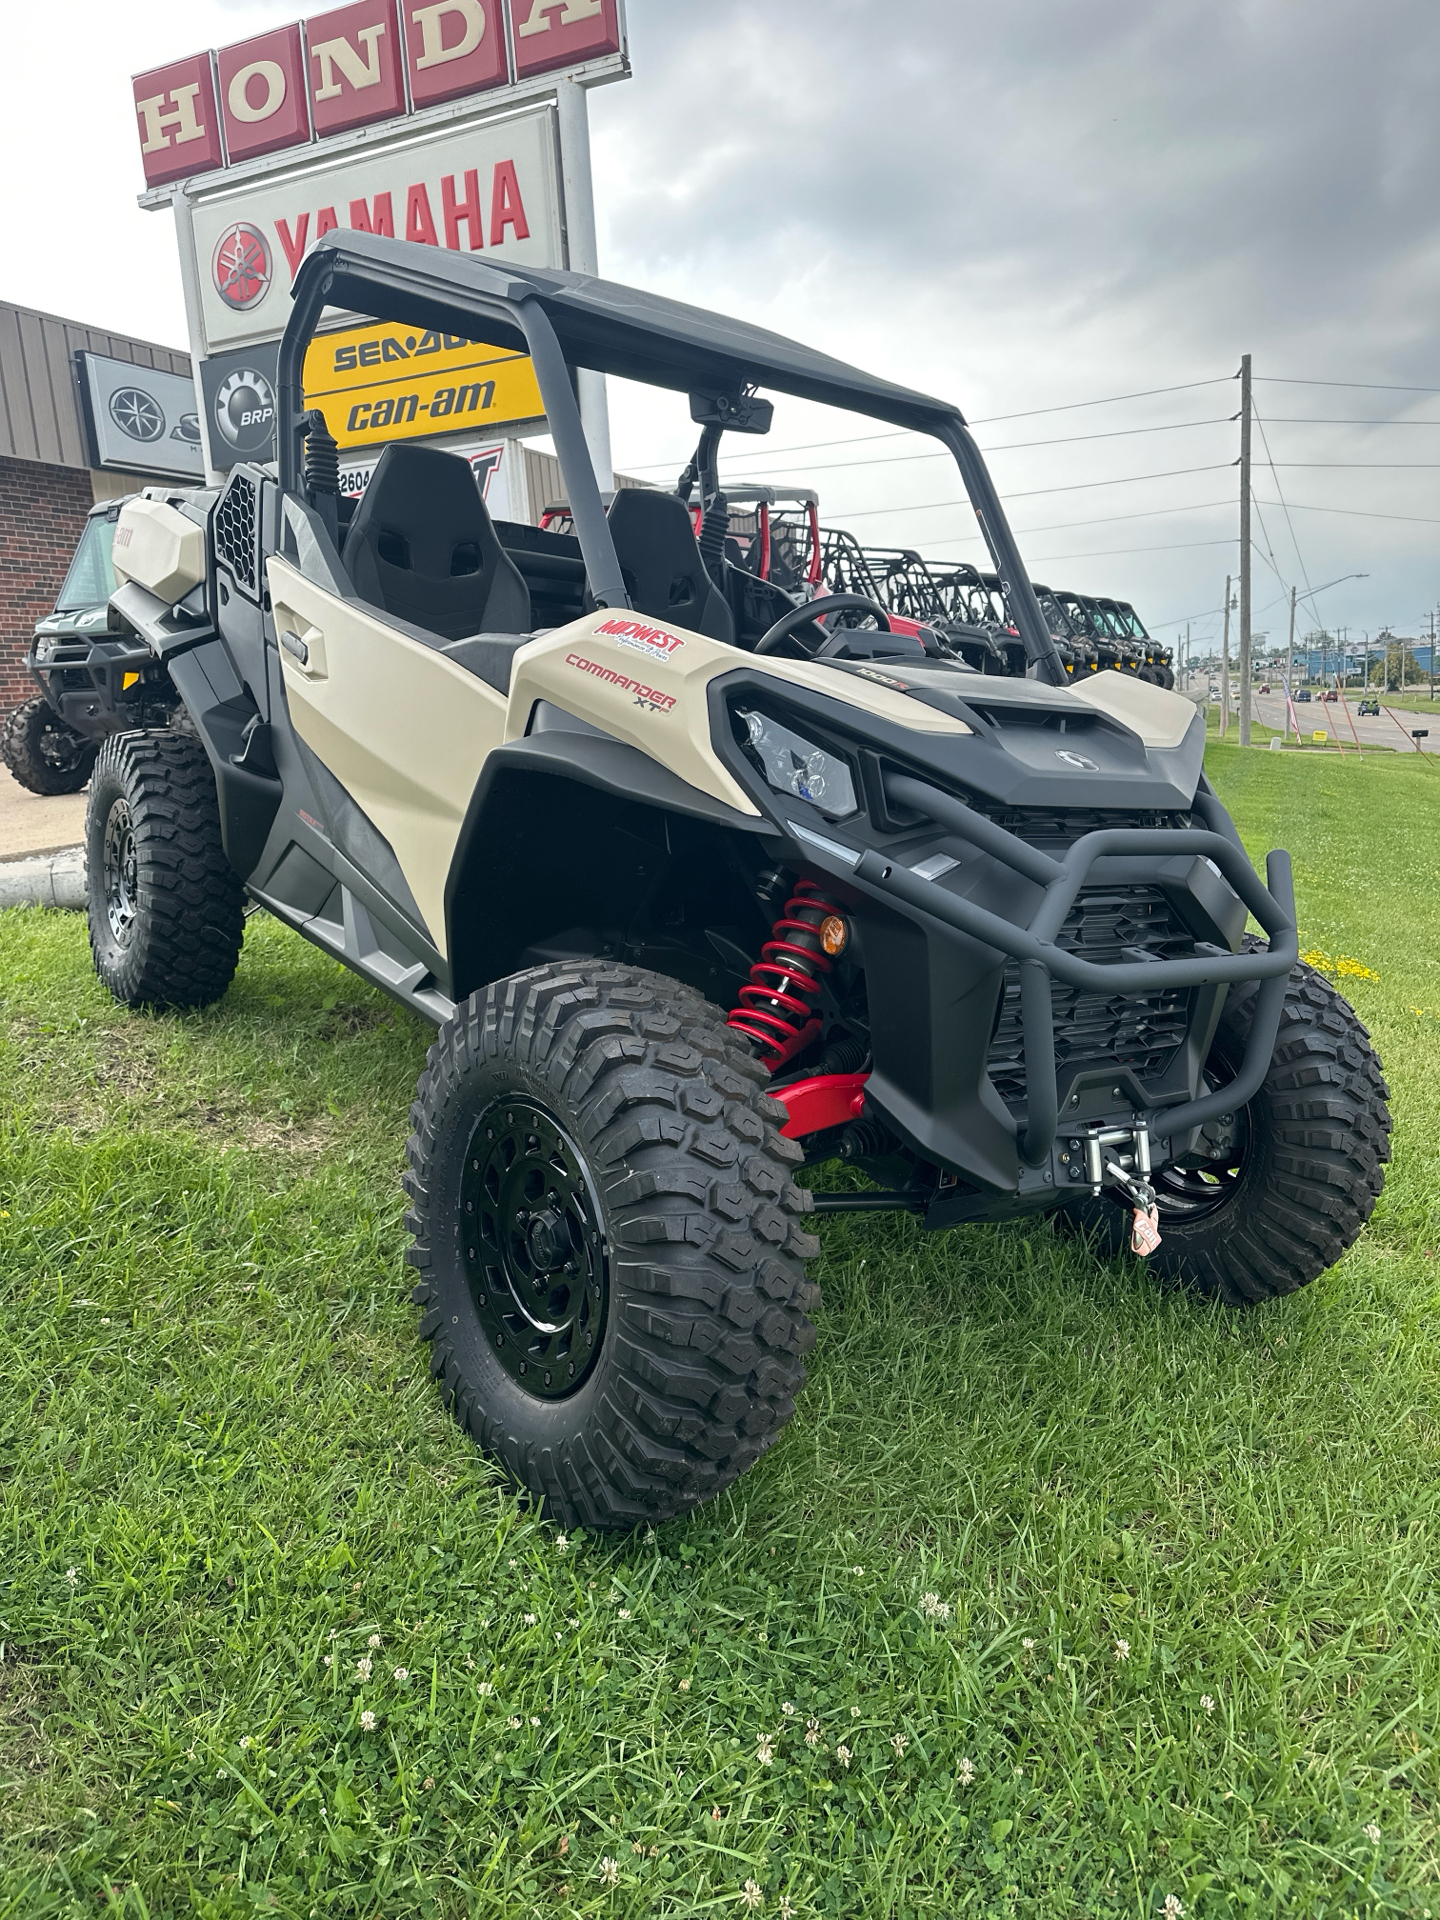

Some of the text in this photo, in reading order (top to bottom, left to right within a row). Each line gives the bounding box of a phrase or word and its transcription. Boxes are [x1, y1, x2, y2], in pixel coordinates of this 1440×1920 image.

[240, 407, 273, 427] BRP
[346, 380, 496, 432] can-am
[594, 619, 684, 652] MIDWEST
[564, 652, 678, 710] COMMANDER
